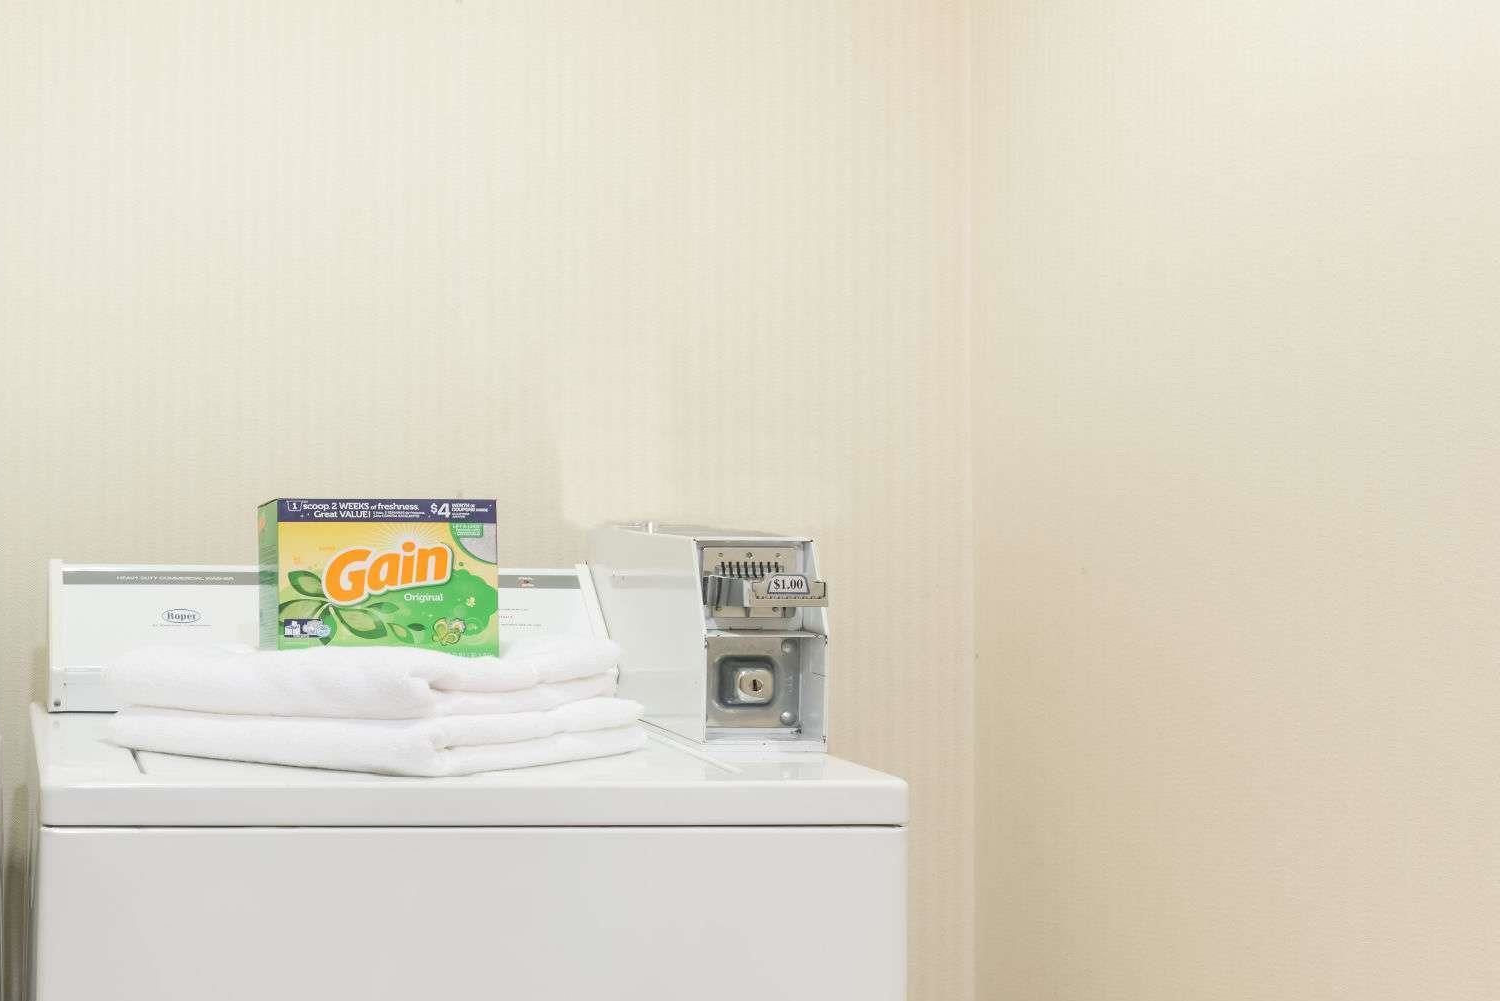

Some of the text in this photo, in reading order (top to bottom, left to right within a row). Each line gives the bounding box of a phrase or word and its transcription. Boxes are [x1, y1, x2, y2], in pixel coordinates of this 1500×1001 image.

[331, 502, 338, 510] 2
[339, 502, 369, 510] WEEKS
[313, 510, 338, 518] Great
[324, 540, 450, 603] Gain
[773, 578, 803, 590] $1.00
[403, 592, 444, 603] Original
[167, 612, 197, 621] Roper
